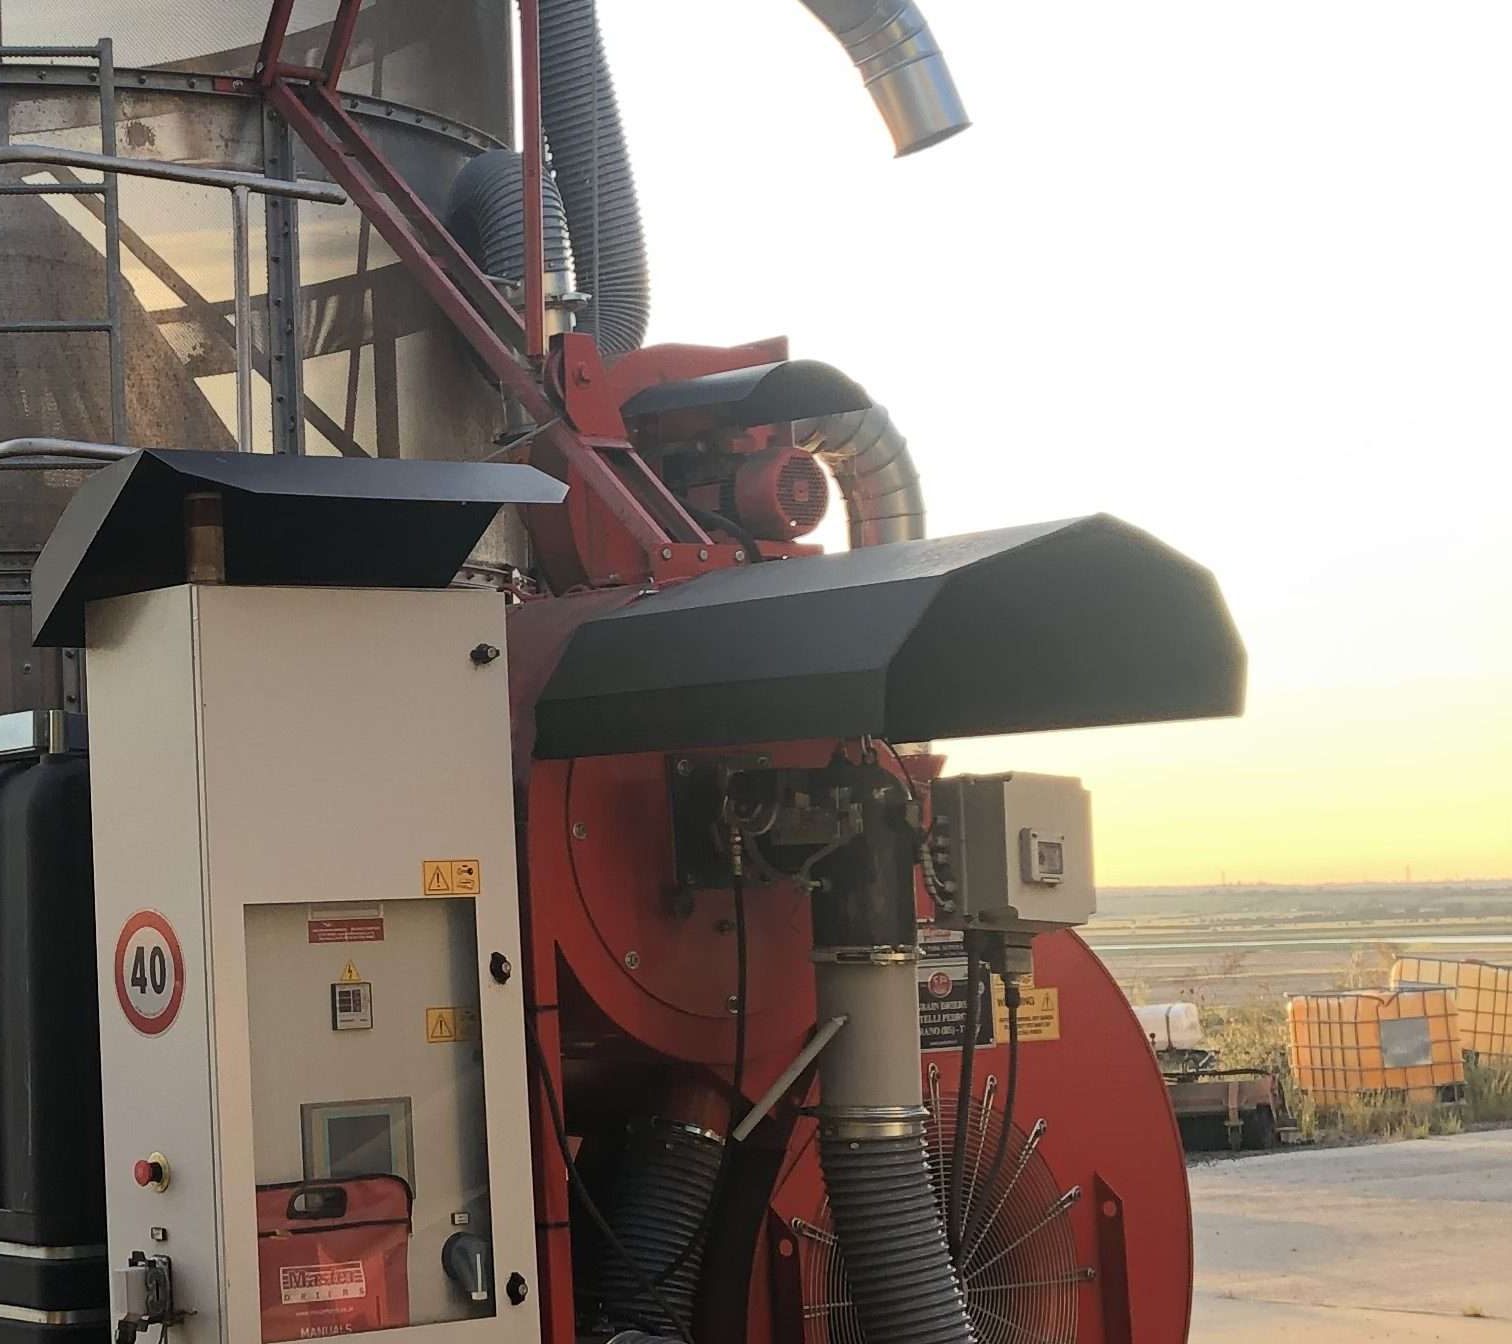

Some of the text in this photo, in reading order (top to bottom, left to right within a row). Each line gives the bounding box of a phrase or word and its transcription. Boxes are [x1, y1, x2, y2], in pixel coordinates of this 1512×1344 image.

[131, 946, 166, 994] 40
[288, 1269, 354, 1288] Master
[300, 1323, 353, 1338] MANUALS
